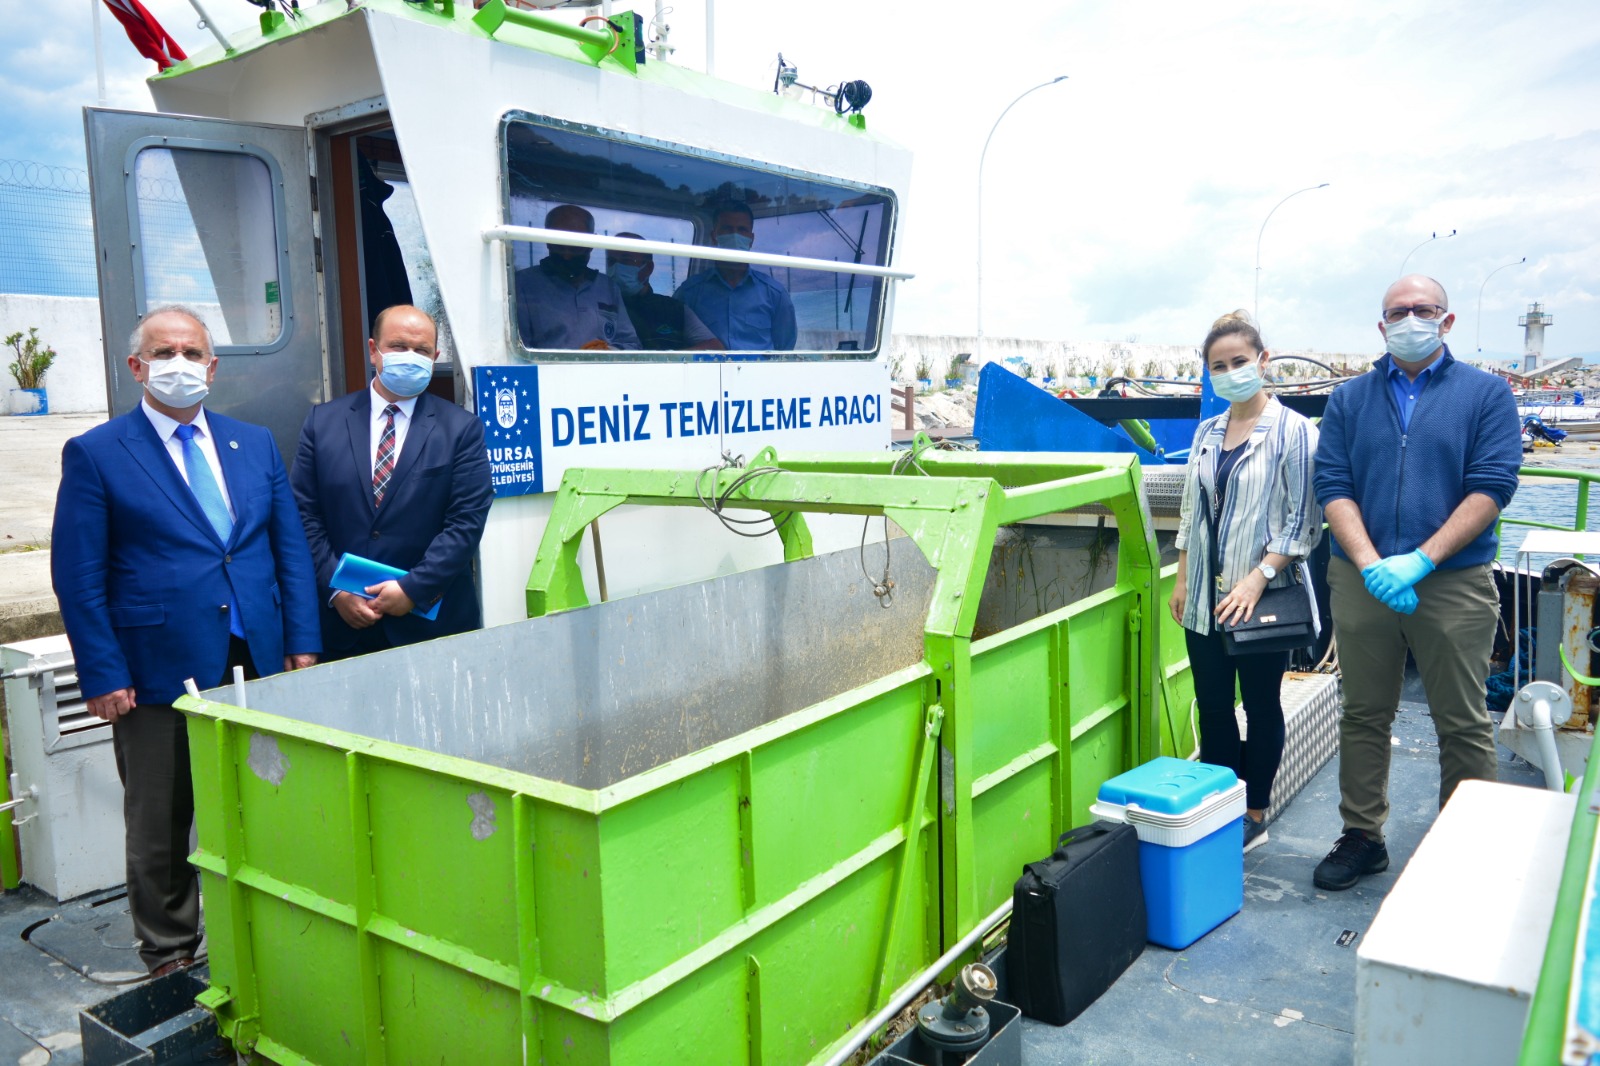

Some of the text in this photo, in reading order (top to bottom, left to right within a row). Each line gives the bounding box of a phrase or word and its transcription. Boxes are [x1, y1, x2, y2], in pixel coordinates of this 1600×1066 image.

[551, 391, 881, 447] DENİZ TEMİZLEME ARACI
[491, 470, 535, 486] ELEDİYESİ
